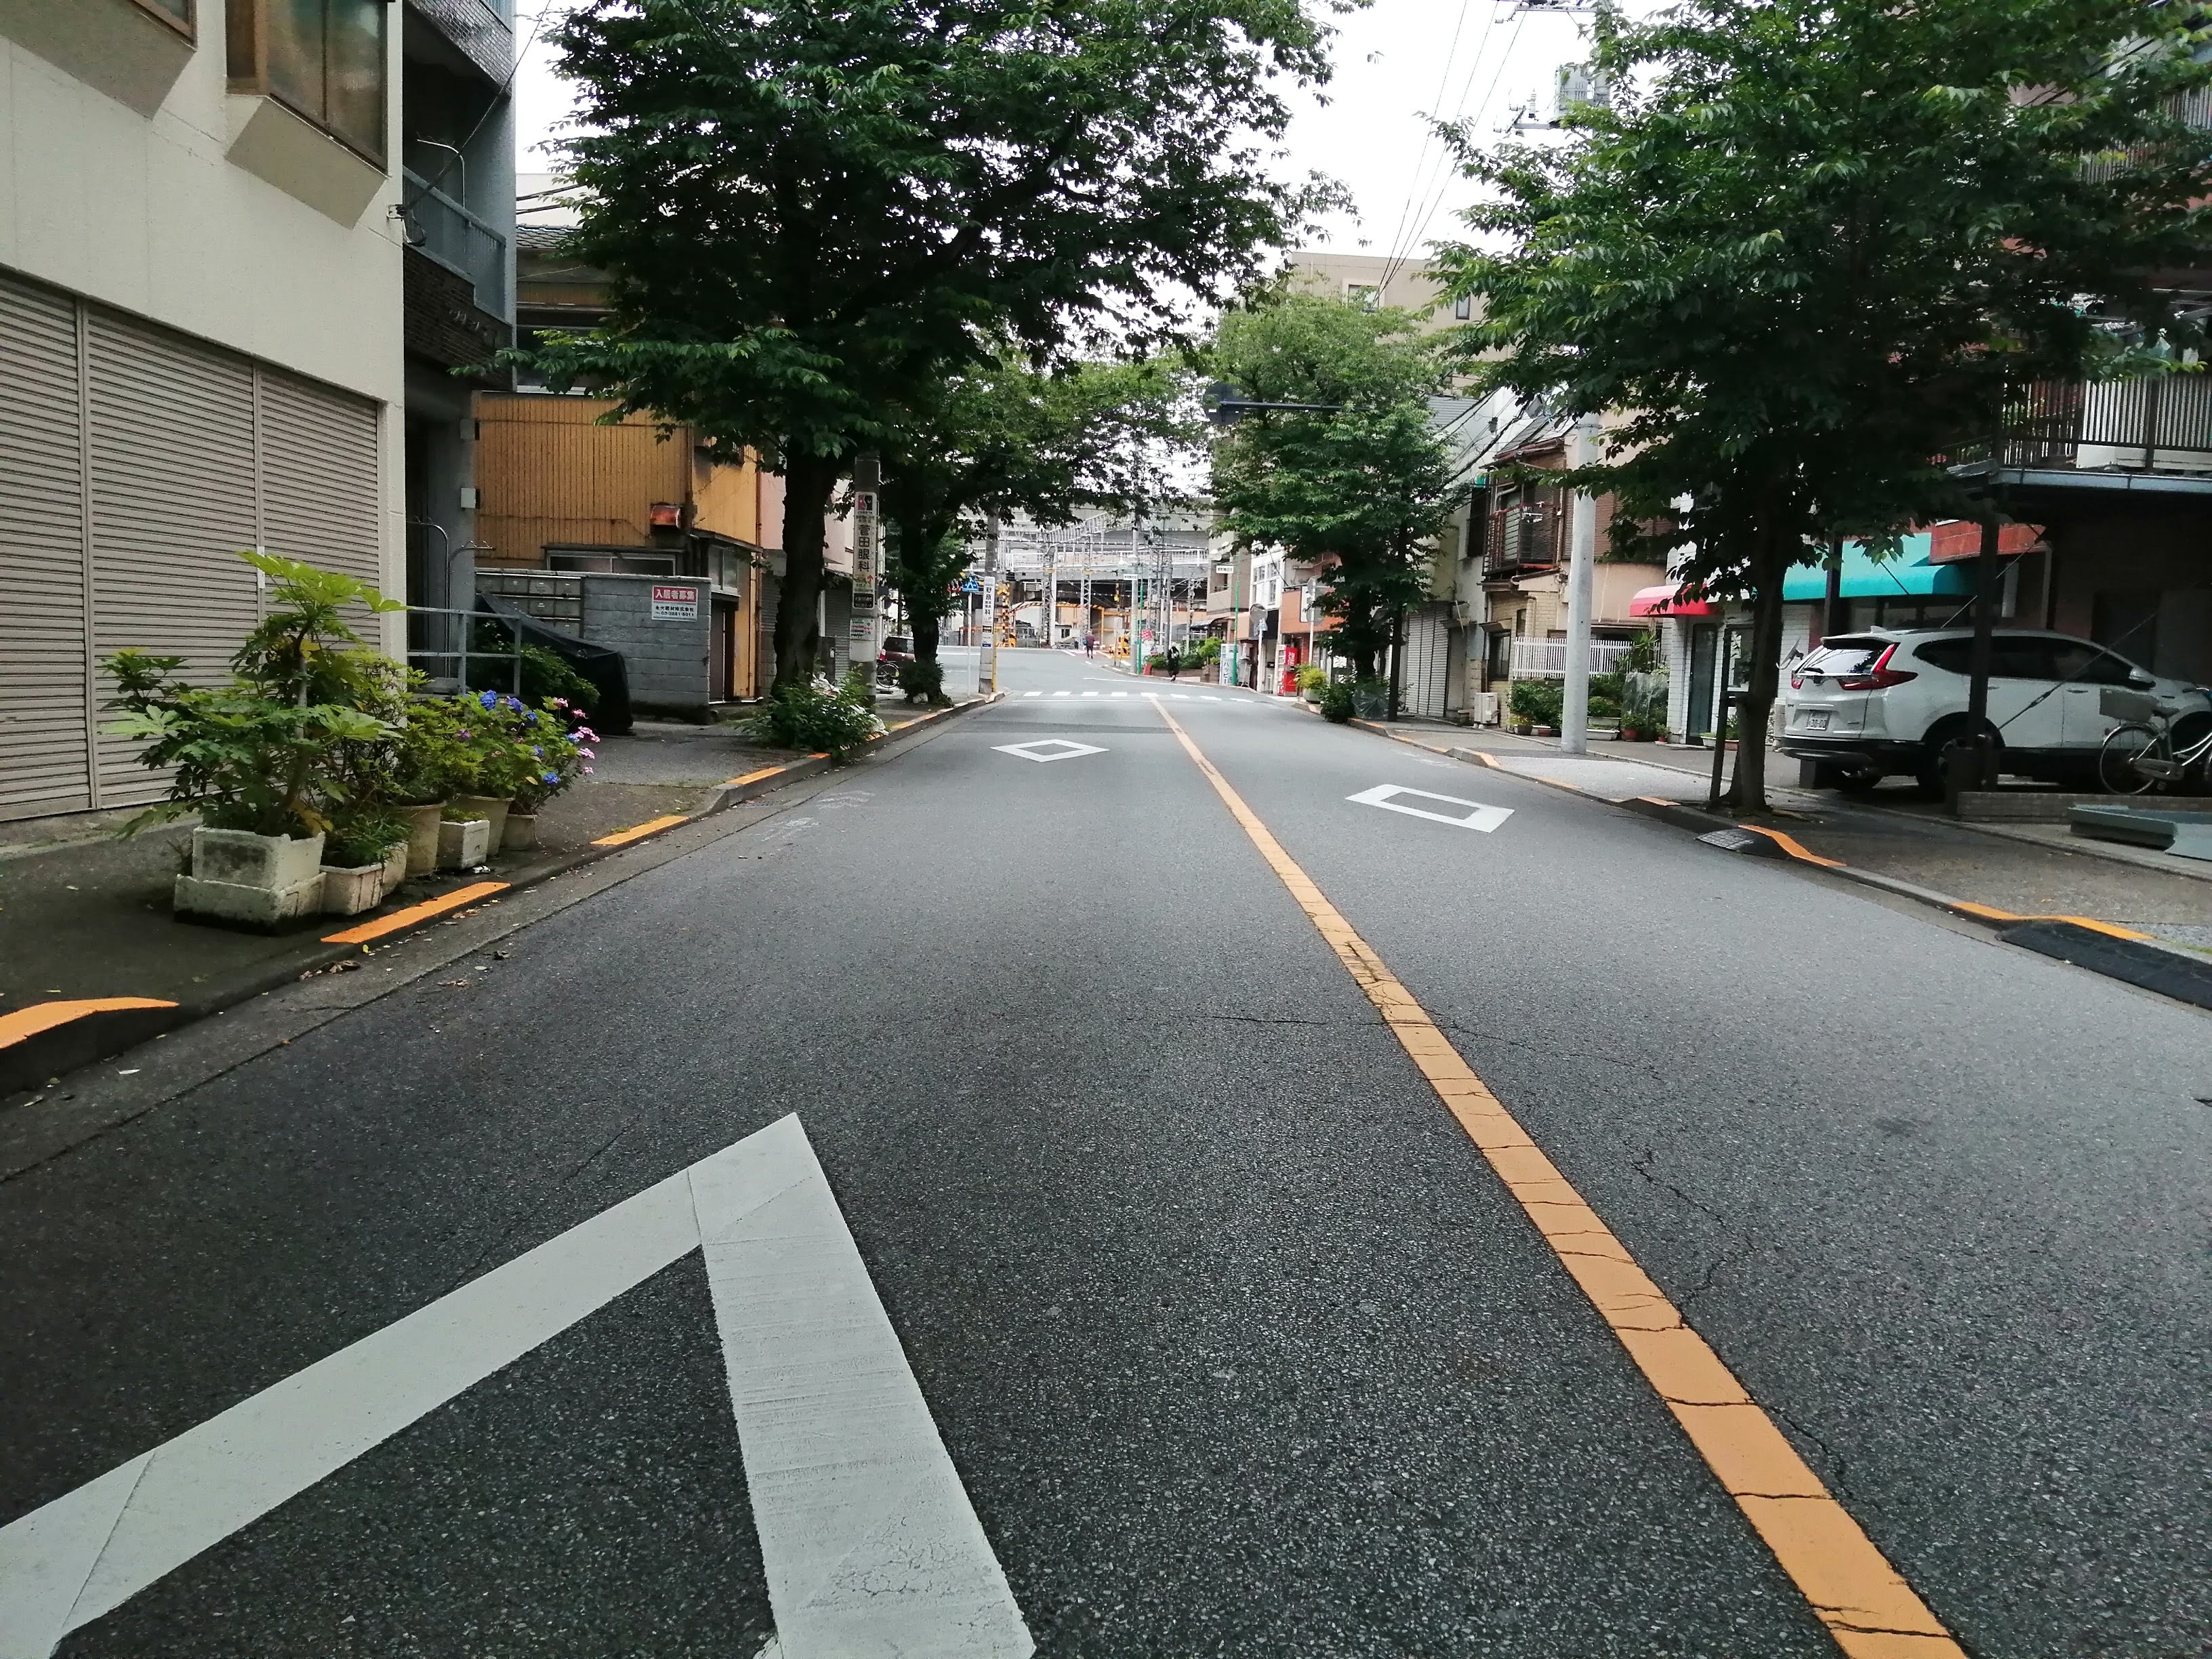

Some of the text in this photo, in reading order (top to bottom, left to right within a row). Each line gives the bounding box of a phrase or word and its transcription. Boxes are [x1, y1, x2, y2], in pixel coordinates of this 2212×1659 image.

[655, 589, 695, 600] 入居者募集
